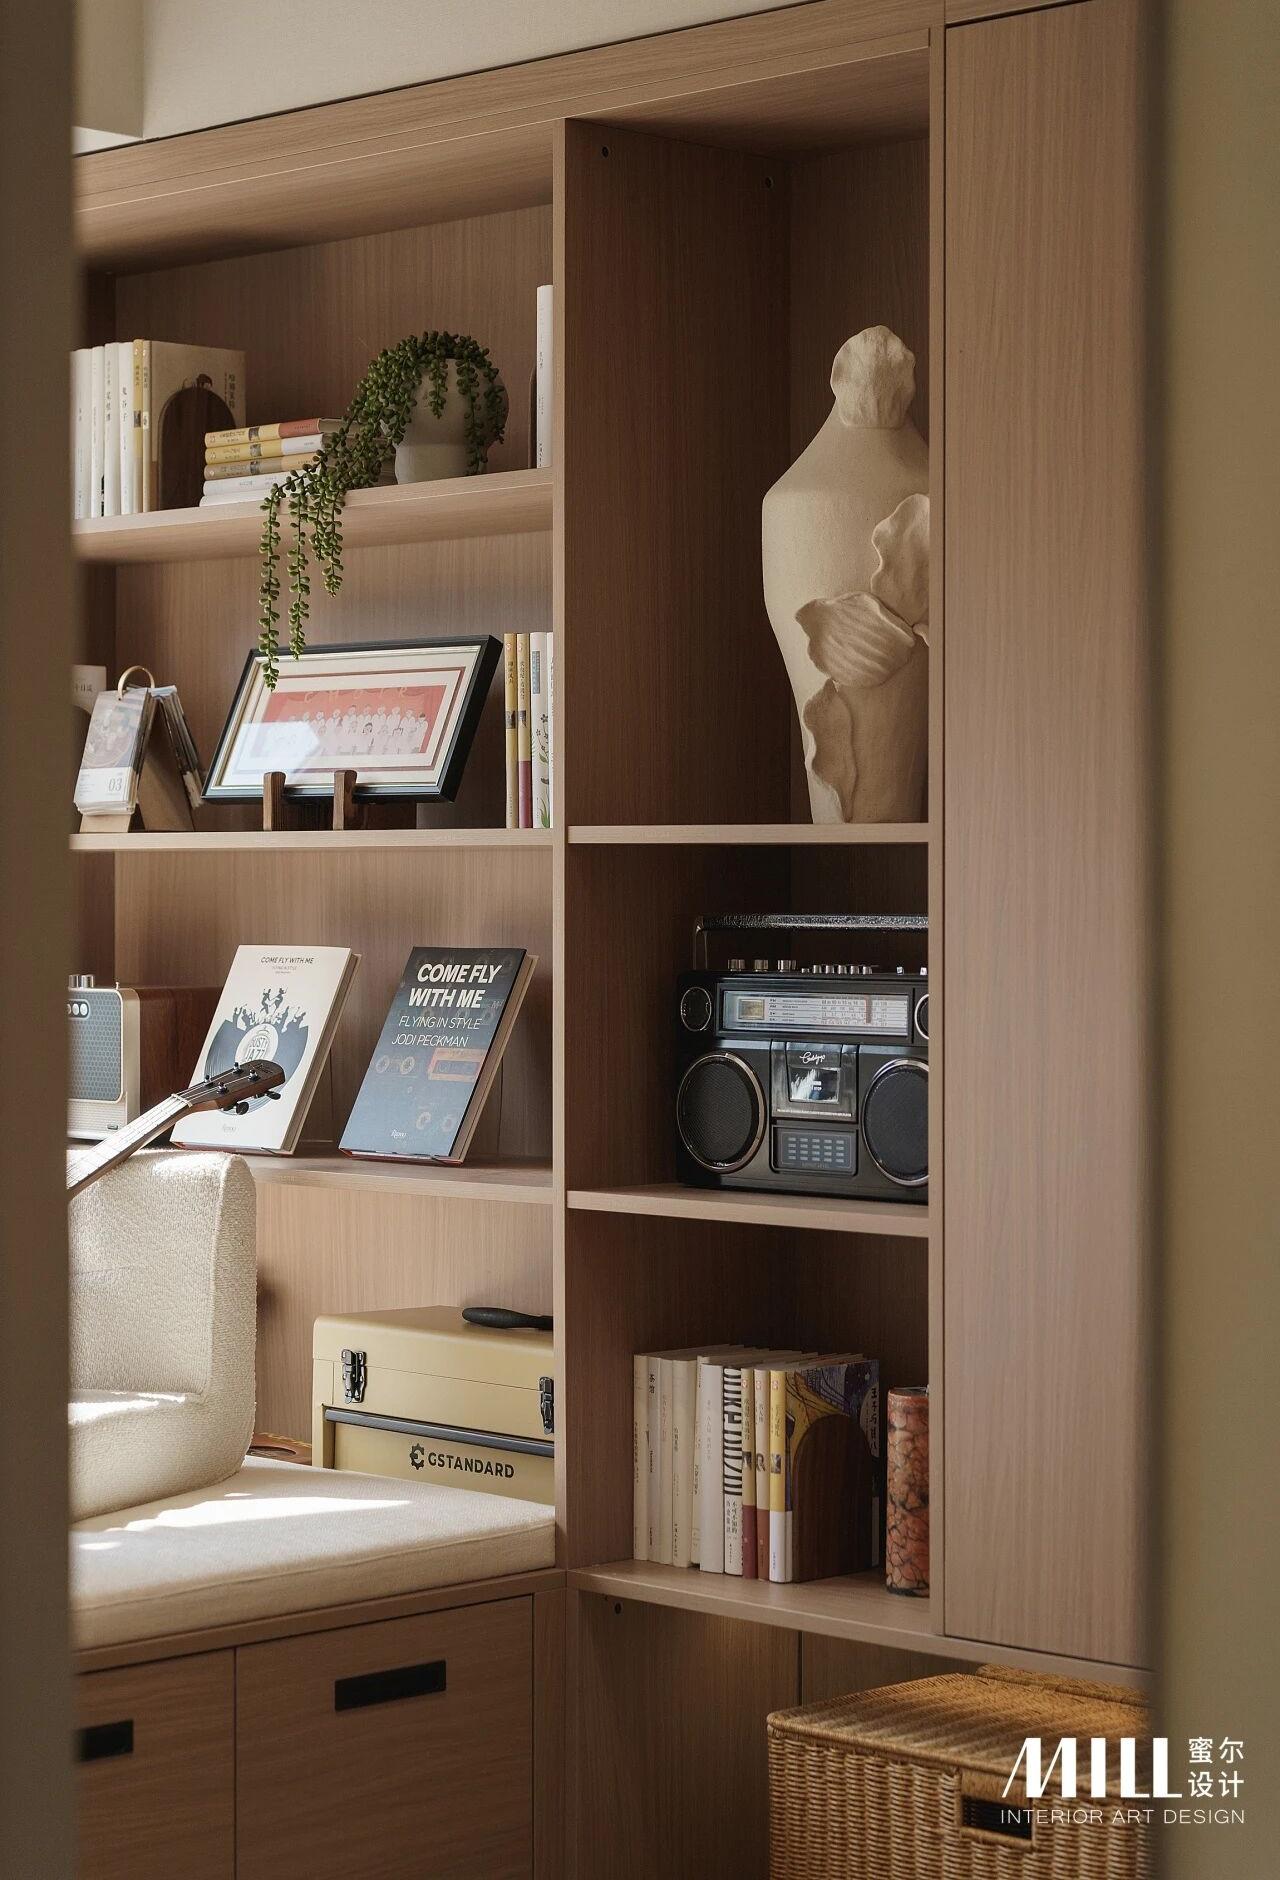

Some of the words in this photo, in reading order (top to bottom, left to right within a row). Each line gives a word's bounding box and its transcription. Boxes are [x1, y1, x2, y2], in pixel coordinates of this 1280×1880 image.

[260, 956, 278, 964] COME
[304, 957, 315, 965] ME
[417, 963, 470, 983] COME
[468, 964, 502, 984] FLY
[408, 987, 457, 1008] WITH
[456, 989, 486, 1009] ME
[398, 1015, 438, 1029] FLYING
[437, 1016, 449, 1029] IN
[448, 1016, 483, 1030] STYLE
[391, 1033, 418, 1045] JODI
[417, 1034, 470, 1047] PECKMAN
[428, 1452, 515, 1479] GSTANDARD
